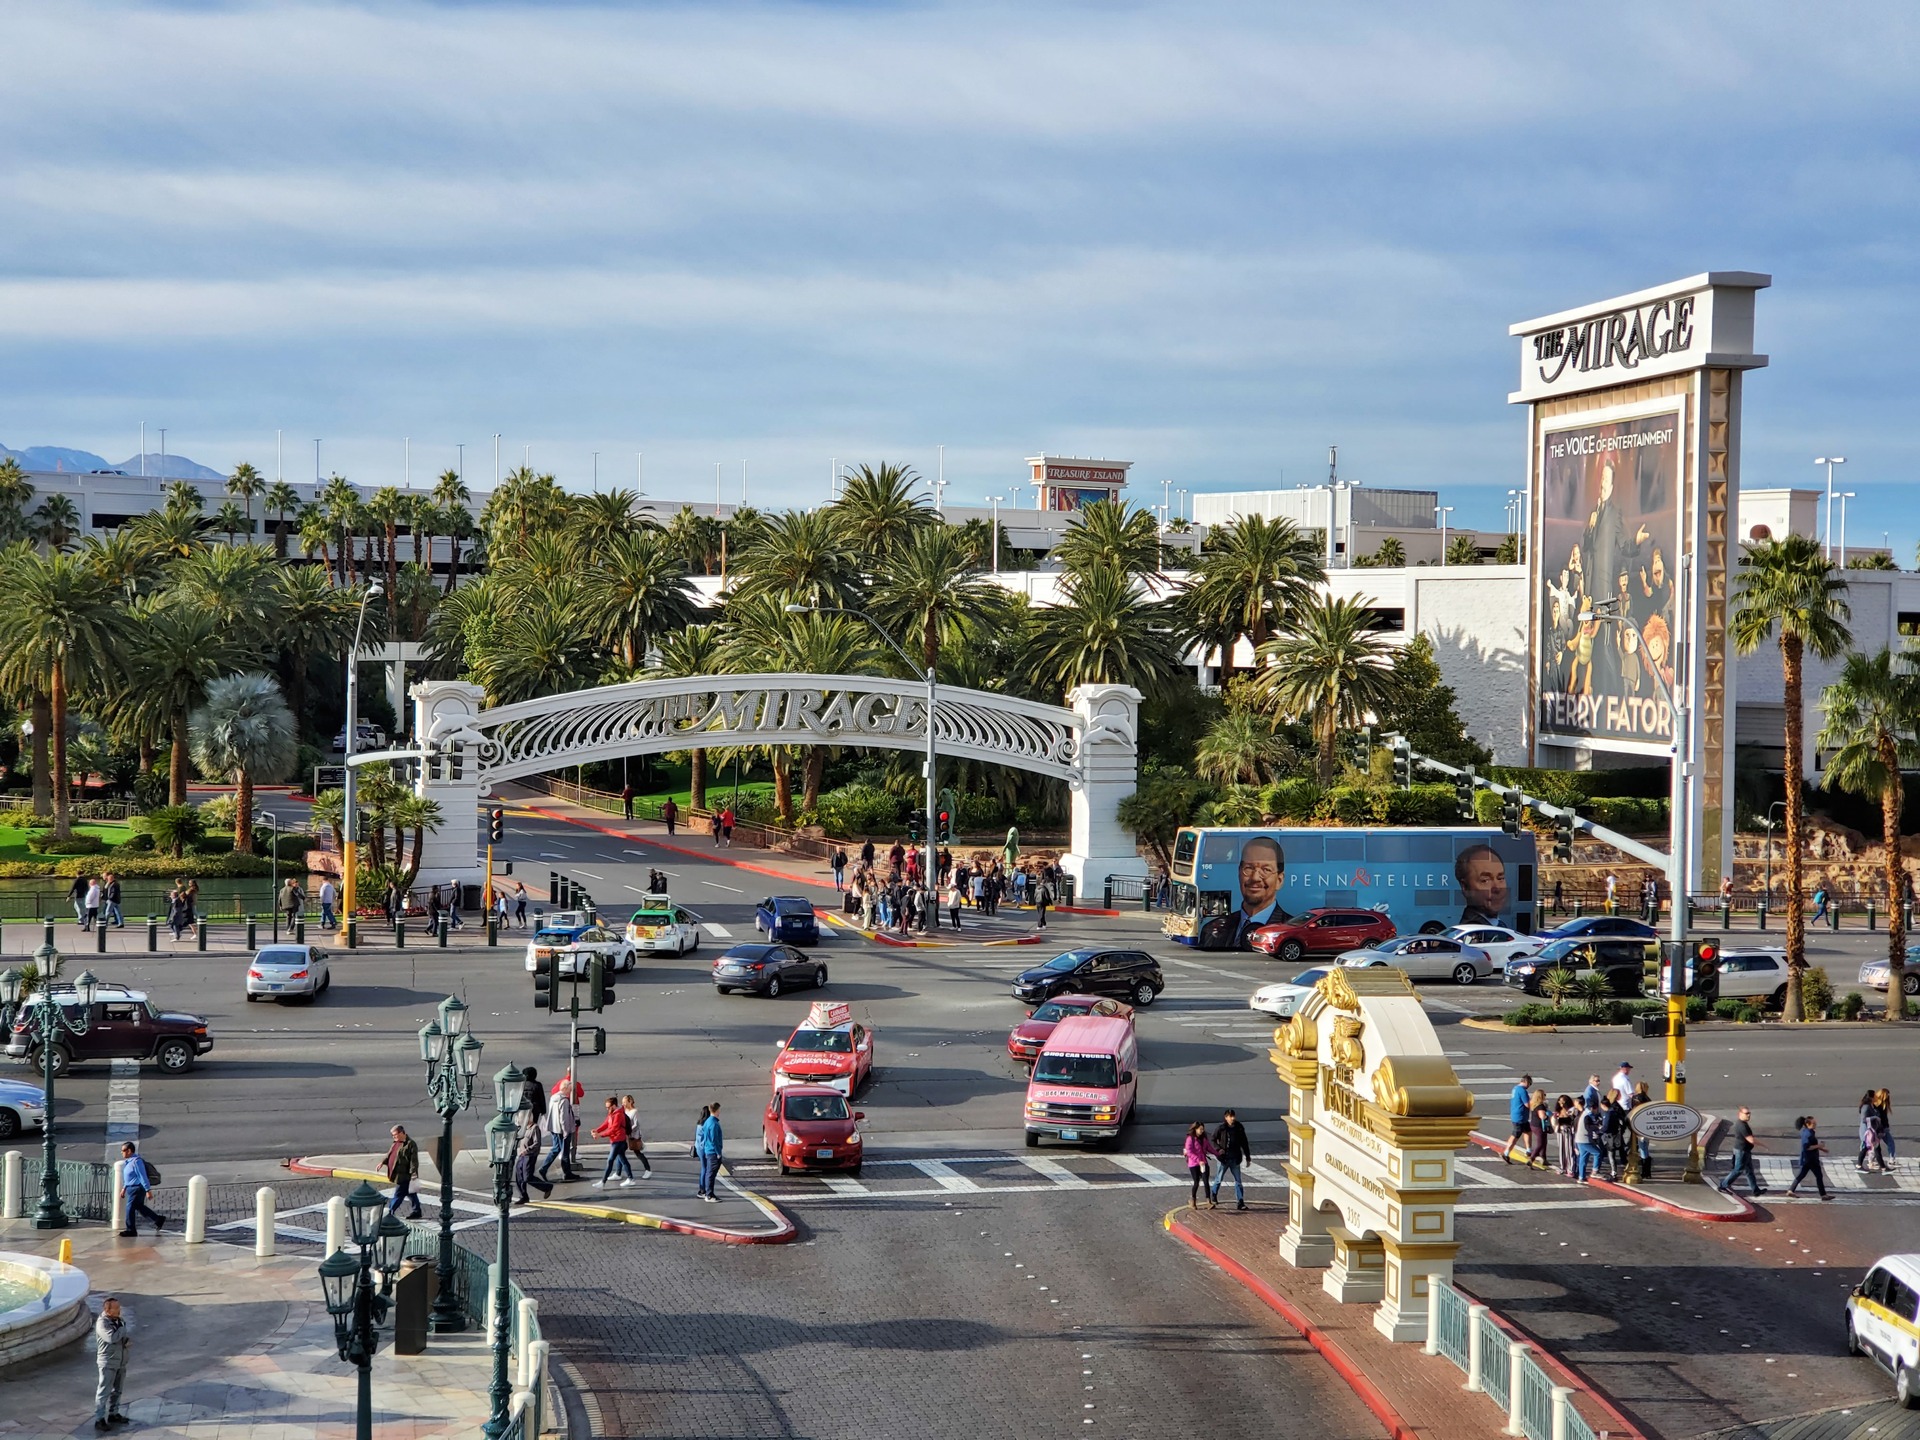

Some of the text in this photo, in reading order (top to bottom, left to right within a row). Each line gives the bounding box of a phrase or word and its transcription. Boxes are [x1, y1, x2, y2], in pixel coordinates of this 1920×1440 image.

[1533, 296, 1695, 383] THE MIRAGE
[1550, 428, 1673, 459] THE VOICE OF ENTERTAINMENT
[1048, 468, 1124, 481] TREASURE ISLAND
[641, 688, 930, 736] THE MIRAGE
[1543, 691, 1672, 737] TERRY FATOR
[1290, 867, 1449, 887] PENN & TELLER
[1325, 1152, 1384, 1200] GRAND CANAL SHOPPES
